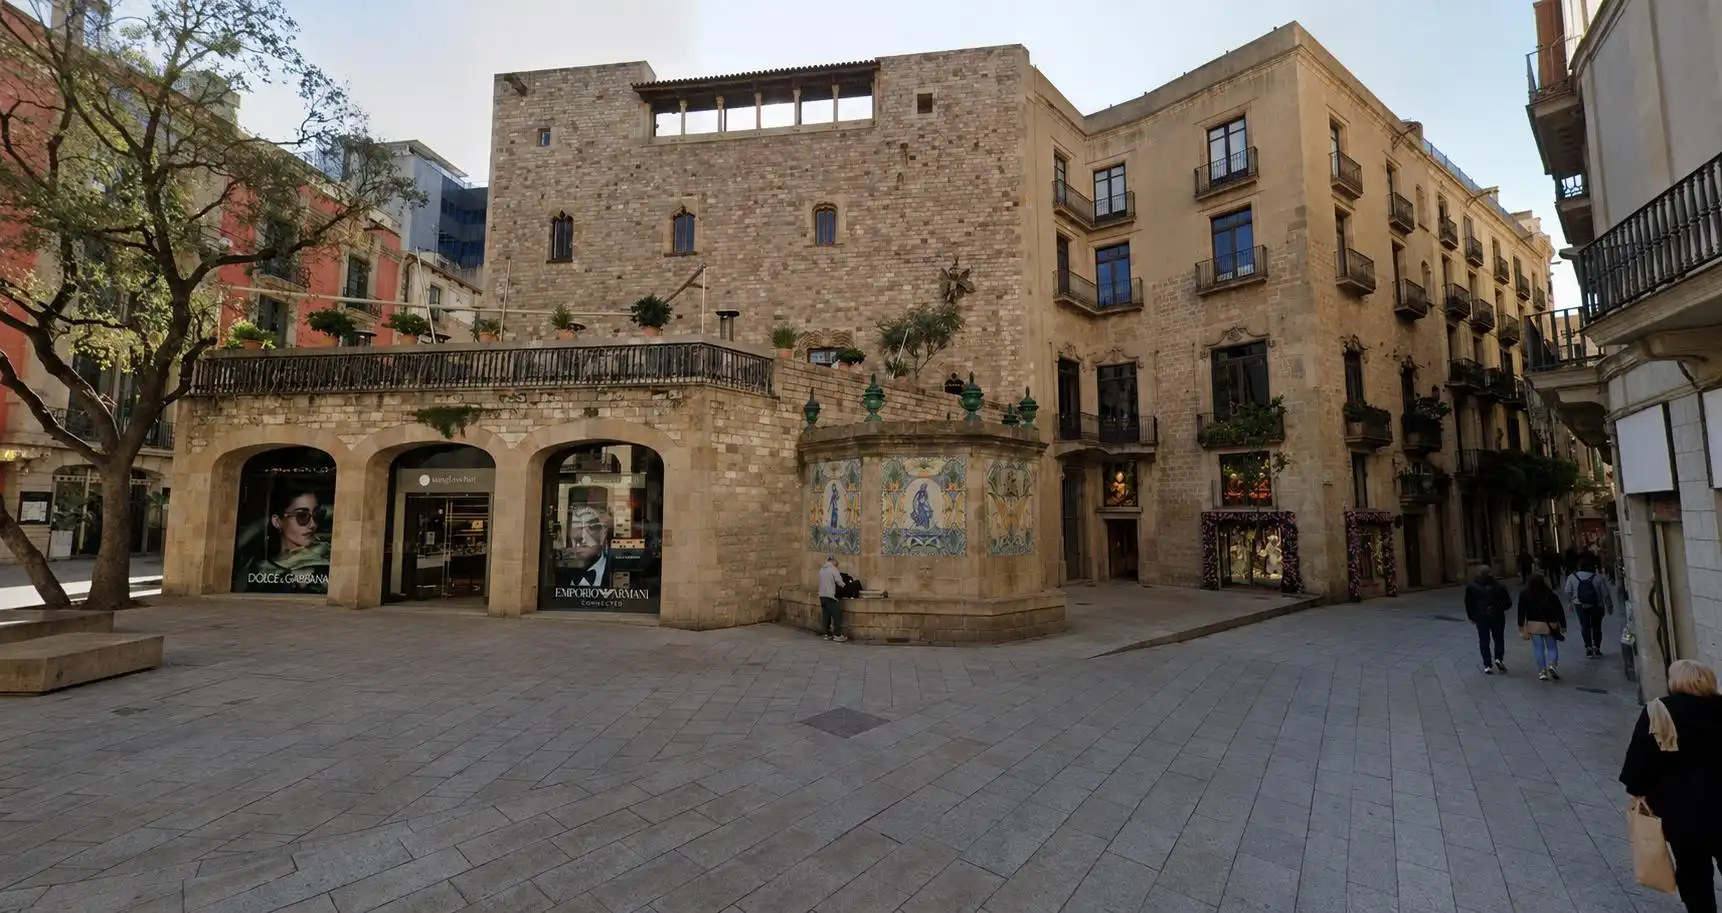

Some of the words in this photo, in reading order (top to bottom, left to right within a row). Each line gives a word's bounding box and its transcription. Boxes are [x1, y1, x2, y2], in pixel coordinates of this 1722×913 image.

[248, 572, 280, 584] DOLCE
[285, 572, 329, 584] GABBANA
[555, 587, 600, 599] EMPORIO
[611, 588, 649, 600] ARMANI
